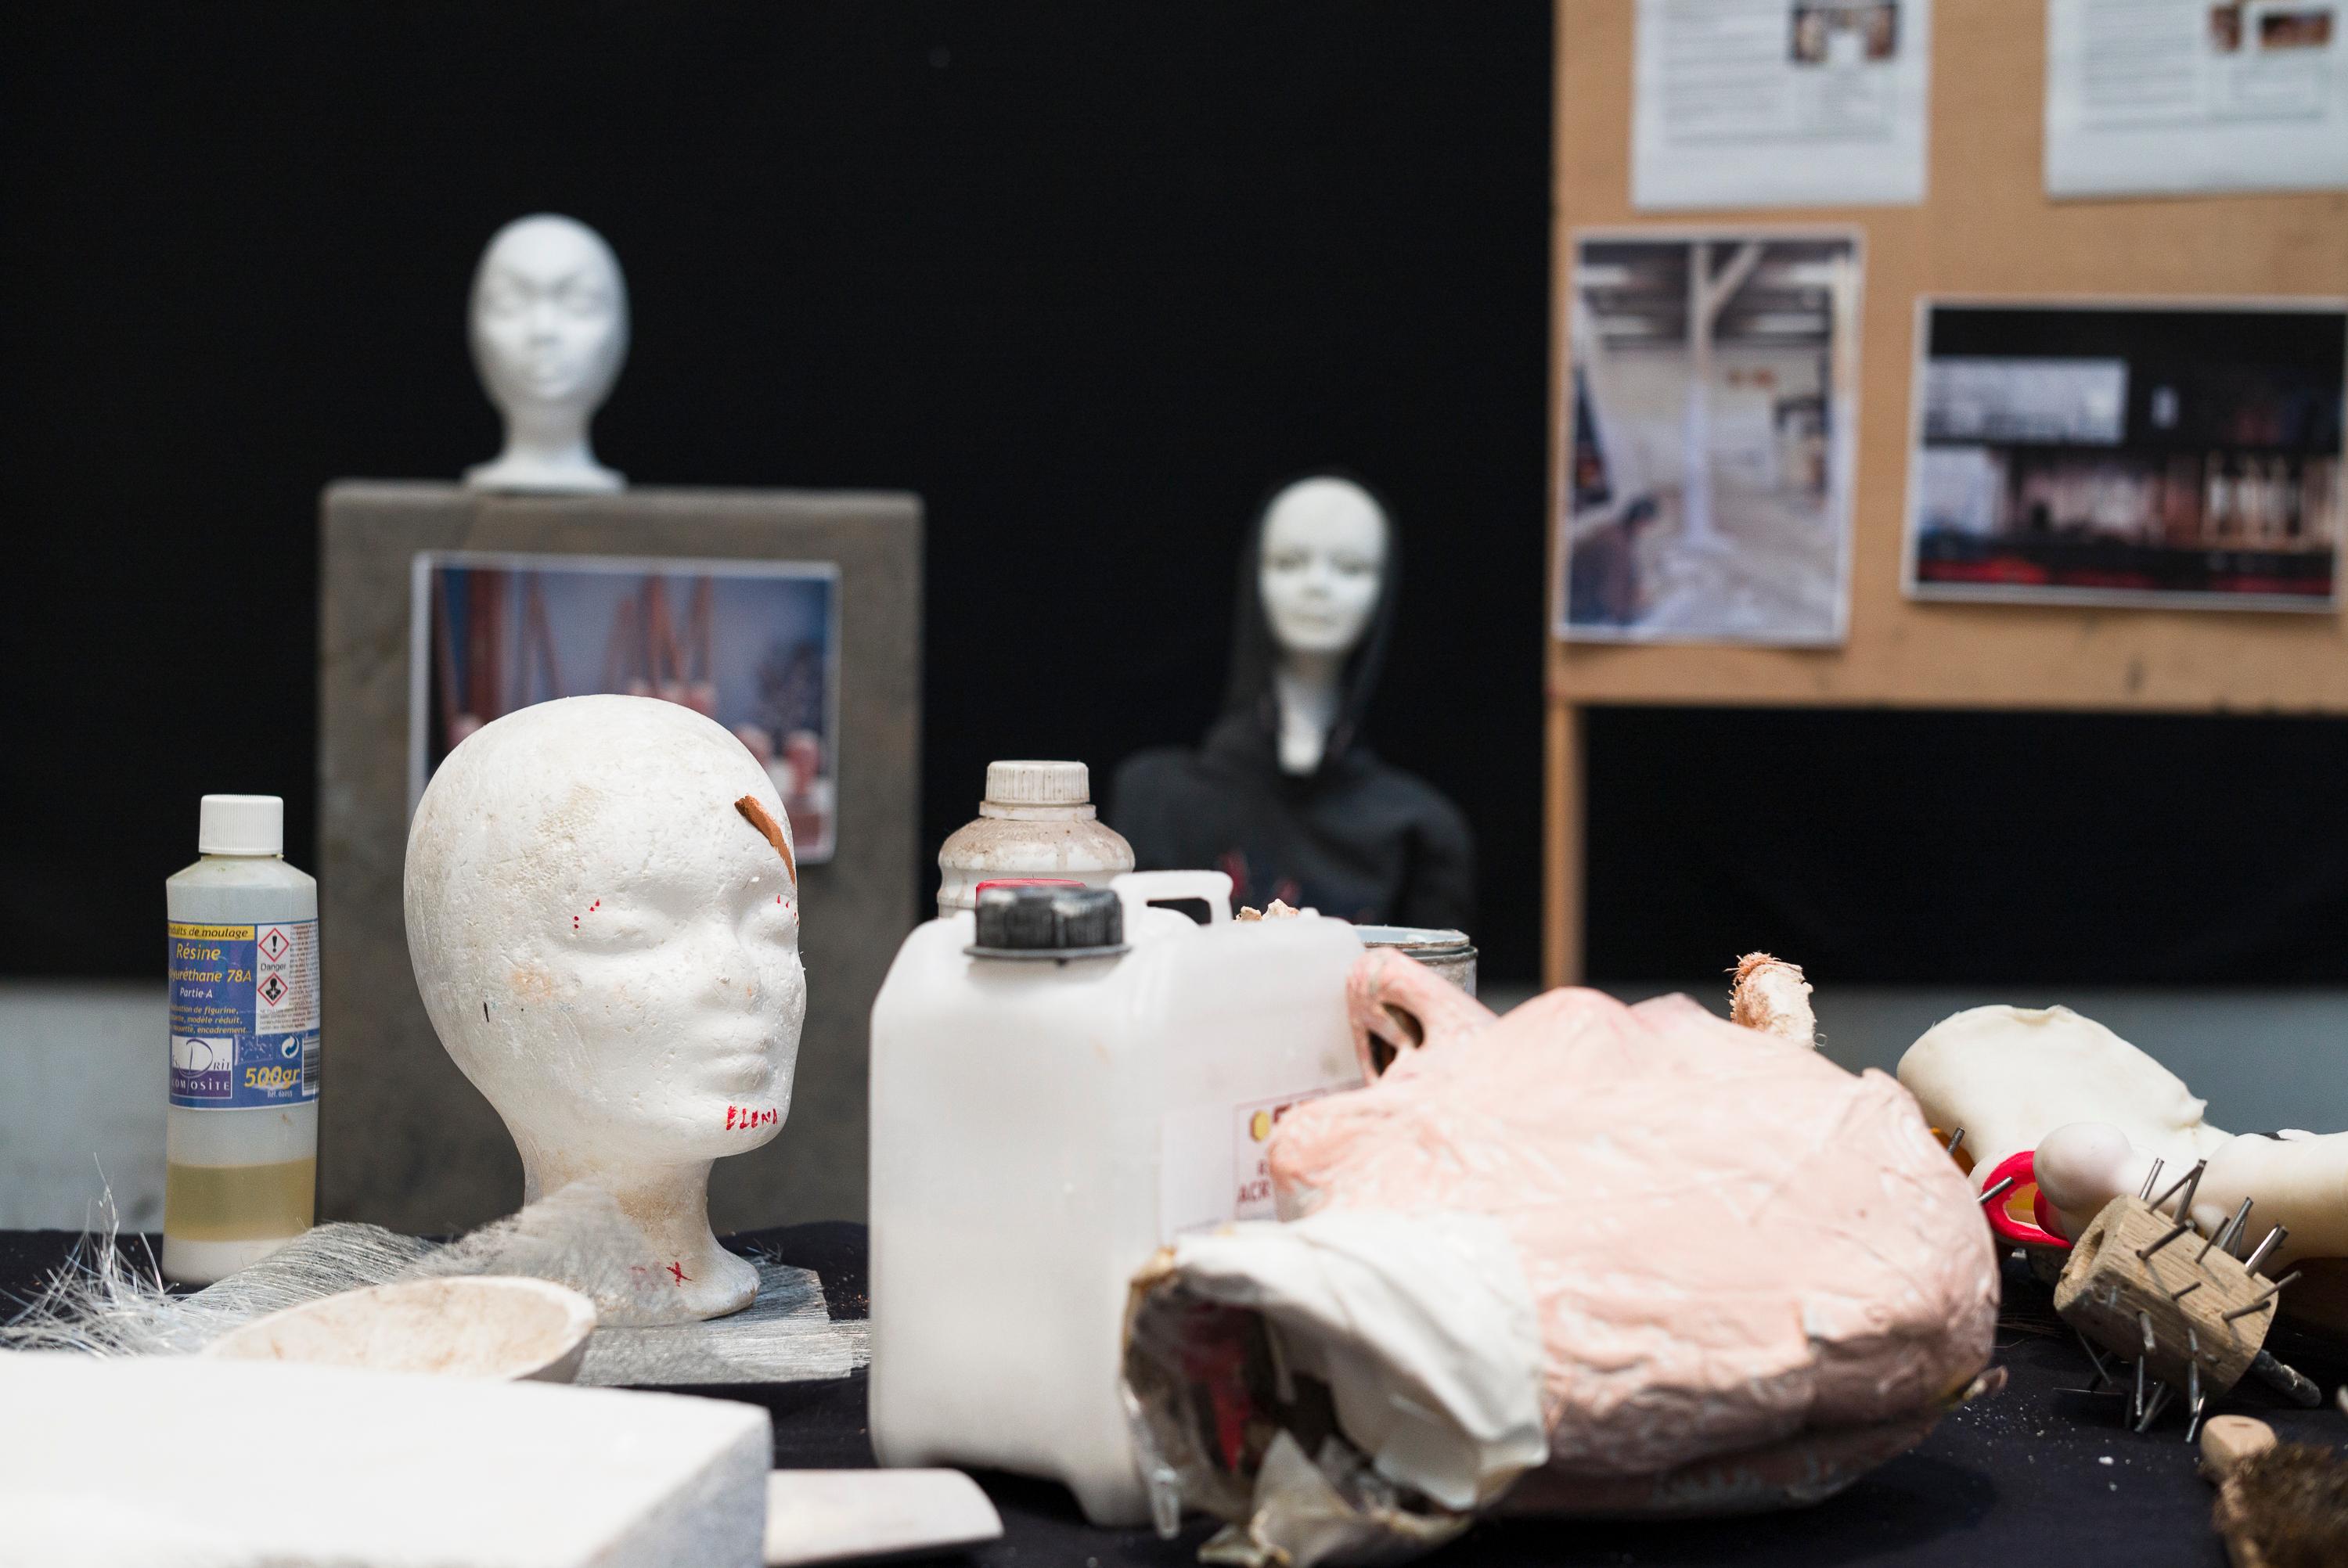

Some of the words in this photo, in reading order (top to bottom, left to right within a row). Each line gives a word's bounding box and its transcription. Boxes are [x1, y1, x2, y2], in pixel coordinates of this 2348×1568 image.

[189, 928, 200, 937] de
[202, 928, 248, 939] moulage
[177, 942, 221, 961] Résine
[261, 962, 286, 971] Danger
[227, 969, 251, 983] 78A
[180, 987, 203, 998] Partie
[206, 989, 213, 998] A
[204, 1006, 239, 1016] figurine,
[244, 1066, 301, 1089] 500gr
